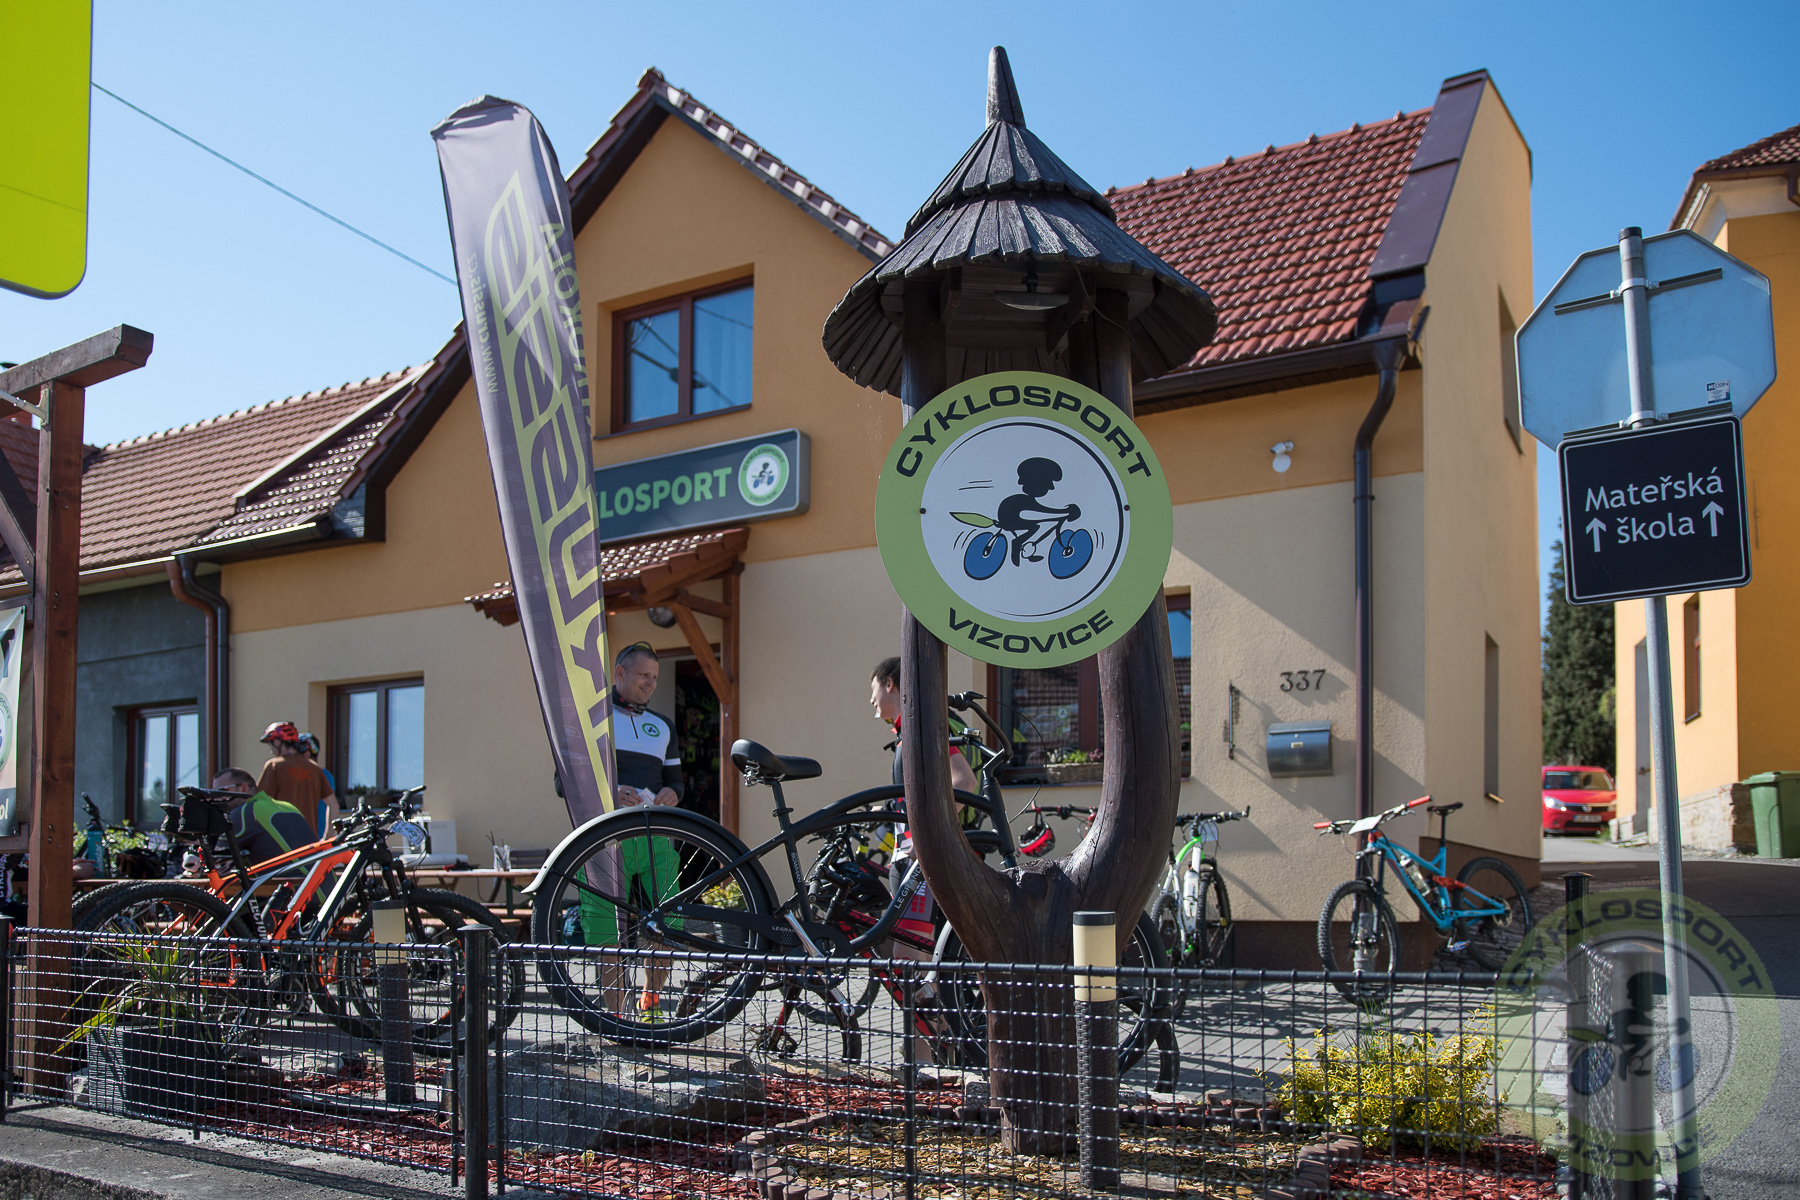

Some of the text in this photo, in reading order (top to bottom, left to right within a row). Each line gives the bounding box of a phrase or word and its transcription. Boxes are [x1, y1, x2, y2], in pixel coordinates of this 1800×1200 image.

[896, 385, 1152, 478] CYKLOSPORT
[598, 467, 732, 519] LOSPORT
[1585, 467, 1724, 512] Mateřská
[1617, 513, 1696, 544] škola
[949, 606, 1114, 654] VIZOVICE
[1280, 669, 1326, 692] 337
[790, 852, 802, 883] BOWMAN
[894, 897, 906, 910] LE
